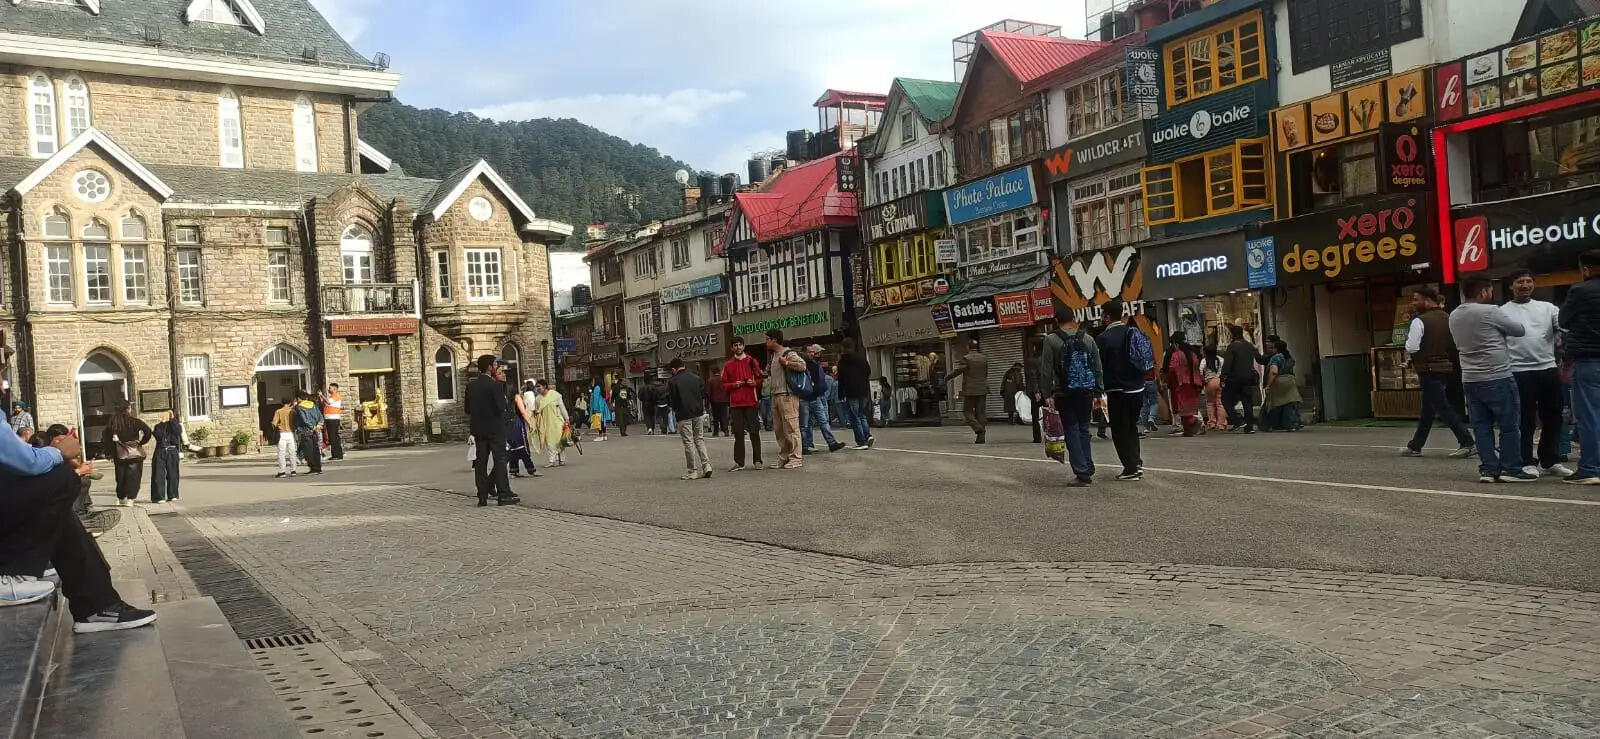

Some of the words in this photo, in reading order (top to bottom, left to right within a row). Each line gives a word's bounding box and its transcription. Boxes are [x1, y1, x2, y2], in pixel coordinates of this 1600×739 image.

[1152, 123, 1189, 144] wake
[1212, 105, 1251, 127] bake
[1077, 131, 1142, 164] WILDCRAFT
[1391, 164, 1424, 176] xero
[1392, 175, 1426, 187] degrees
[953, 188, 982, 210] Photo
[985, 176, 1024, 200] Palace
[1337, 206, 1415, 240] xero
[1490, 216, 1587, 250] Hideout
[1248, 239, 1273, 249] wake
[1282, 233, 1417, 278] degrees
[969, 265, 987, 277] Photo
[987, 261, 1011, 274] Palace
[953, 300, 993, 318] Sathe's
[999, 300, 1028, 316] SHREE
[1072, 300, 1147, 323] WILDAFT
[732, 323, 754, 335] UNITED
[755, 318, 779, 332] COLORS
[665, 333, 718, 350] OCTAVE
